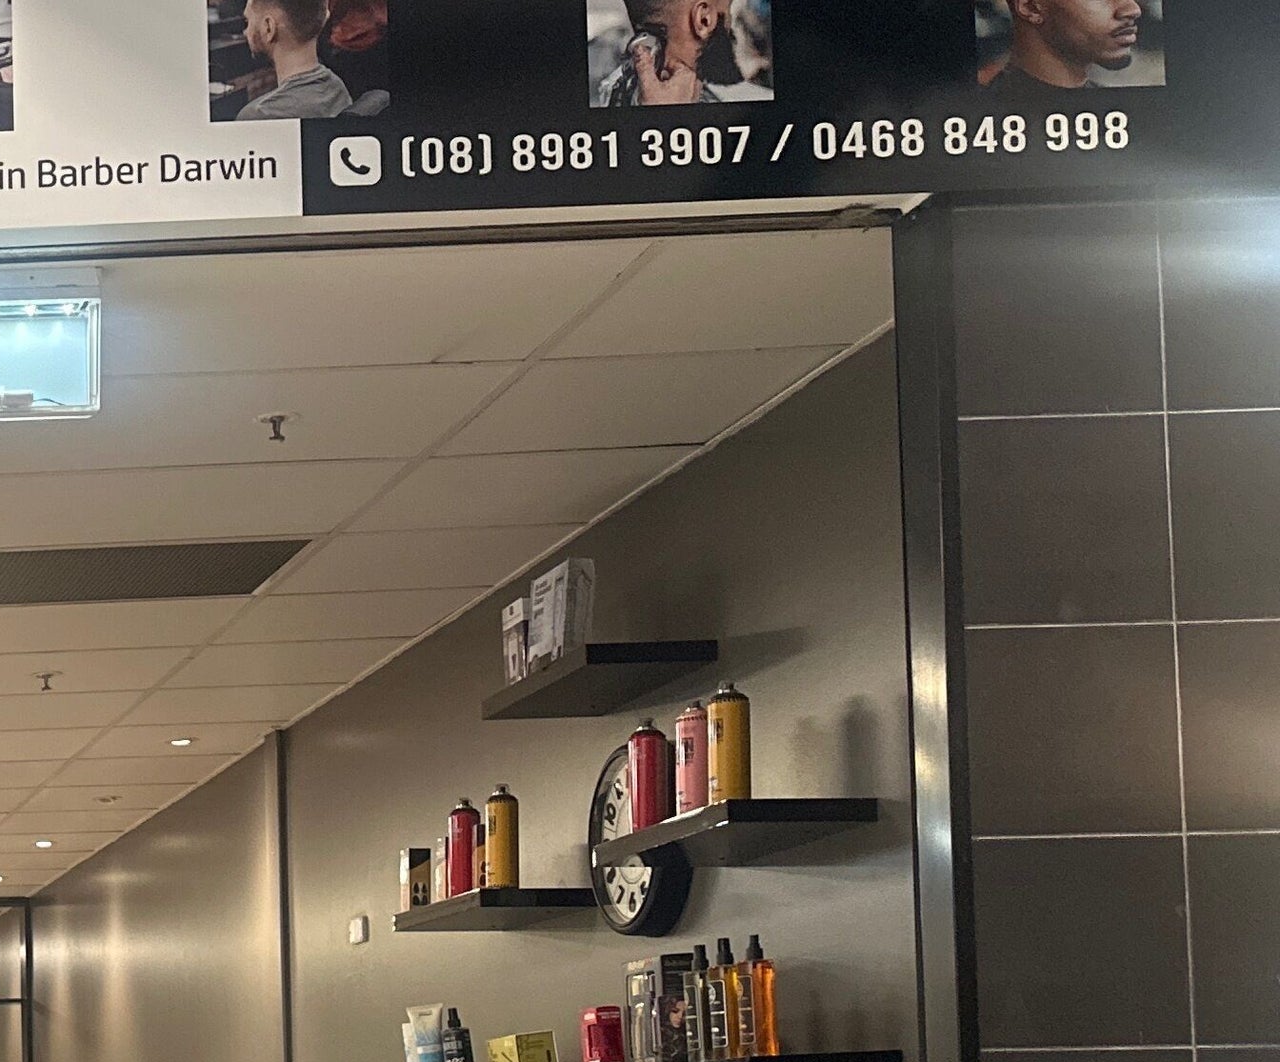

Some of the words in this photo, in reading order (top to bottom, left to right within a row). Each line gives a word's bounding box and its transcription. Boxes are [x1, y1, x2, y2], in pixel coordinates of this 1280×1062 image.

[37, 156, 150, 190] Barber
[159, 150, 279, 184] Darwin
[401, 135, 495, 177] (08)
[512, 131, 620, 172] 8981
[641, 125, 750, 167] 3907
[770, 122, 795, 164] /
[813, 118, 926, 160] 0468
[943, 114, 1028, 155] 848
[1044, 110, 1131, 152] 998
